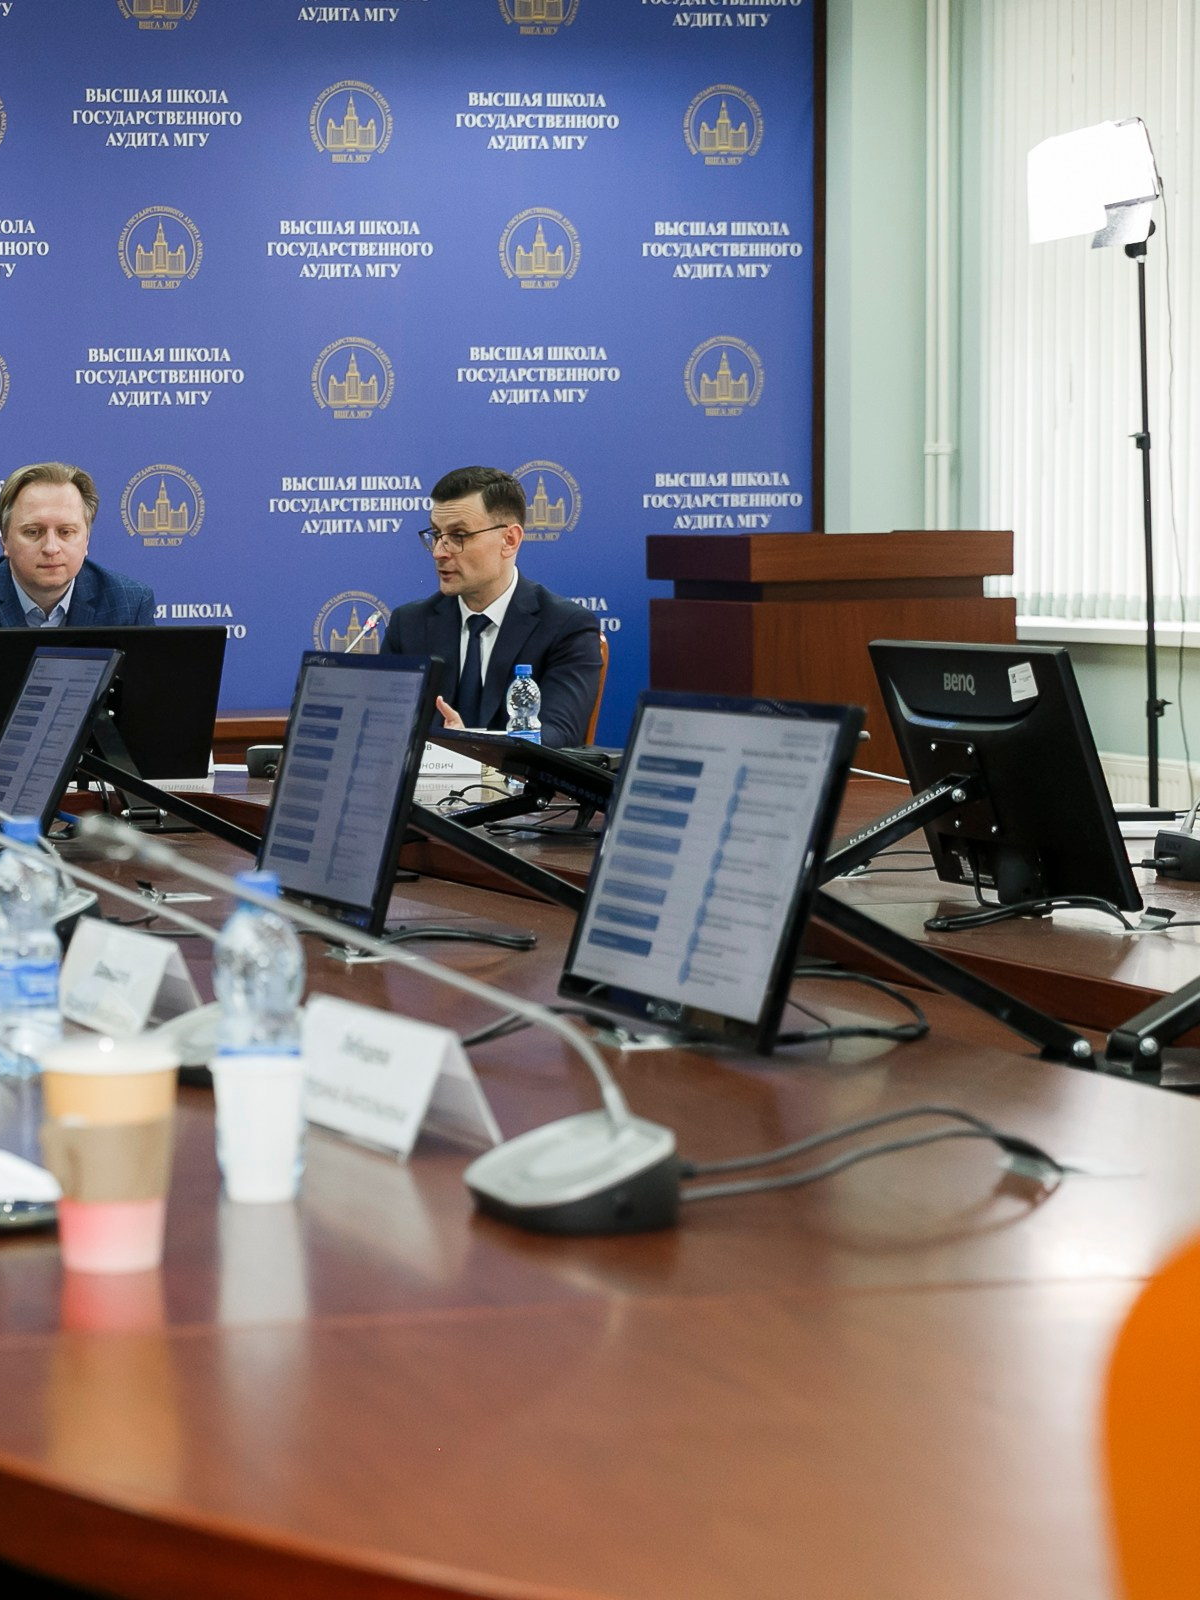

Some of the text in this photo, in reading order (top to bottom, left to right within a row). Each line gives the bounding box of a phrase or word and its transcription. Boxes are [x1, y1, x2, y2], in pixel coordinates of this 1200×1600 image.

[297, 6, 400, 23] АУДИТА МГУ
[672, 12, 772, 28] АУДИТА МГУ
[85, 88, 229, 104] ВЫСШАЯ ШКОЛА
[468, 91, 607, 108] ВЫСШАЯ ШКОЛА
[72, 109, 243, 127] ГОСУДАРСТВЕННОГО
[455, 113, 620, 130] ГОСУДАРСТВЕННОГО
[105, 132, 210, 149] АУДИТА МГУ
[487, 134, 588, 152] АУДИТА МГУ
[279, 220, 421, 235] ВЫСШАЯ ШКОЛА
[654, 221, 791, 236] ВЫСШАЯ ШКОЛА
[267, 241, 434, 259] ГОСУДАРСТВЕННОГО
[642, 242, 803, 259] ГОСУДАРСТВЕННОГО
[299, 263, 402, 280] АУДИТА МГУ
[672, 263, 772, 280] АУДИТА МГУ
[88, 347, 231, 363] ВЫСШАЯ ШКОЛА
[469, 345, 608, 361] ВЫСШАЯ ШКОЛА
[75, 368, 245, 386] ГОСУДАРСТВЕННОГО
[457, 367, 621, 384] ГОСУДАРСТВЕННОГО
[107, 390, 212, 408] АУДИТА МГУ
[488, 388, 589, 406] АУДИТА МГУ
[281, 475, 422, 492] ВЫСШАЯ ШКОЛА
[655, 471, 790, 488] ВЫСШАЯ ШКОЛА
[269, 496, 434, 515] ГОСУДАРСТВЕННОГО
[642, 492, 803, 510] ГОСУДАРСТВЕННОГО
[300, 518, 403, 536] АУДИТА МГУ
[673, 513, 772, 531] АУДИТА МГУ
[171, 603, 234, 619] ШКОЛА
[943, 672, 976, 696] BenQ
